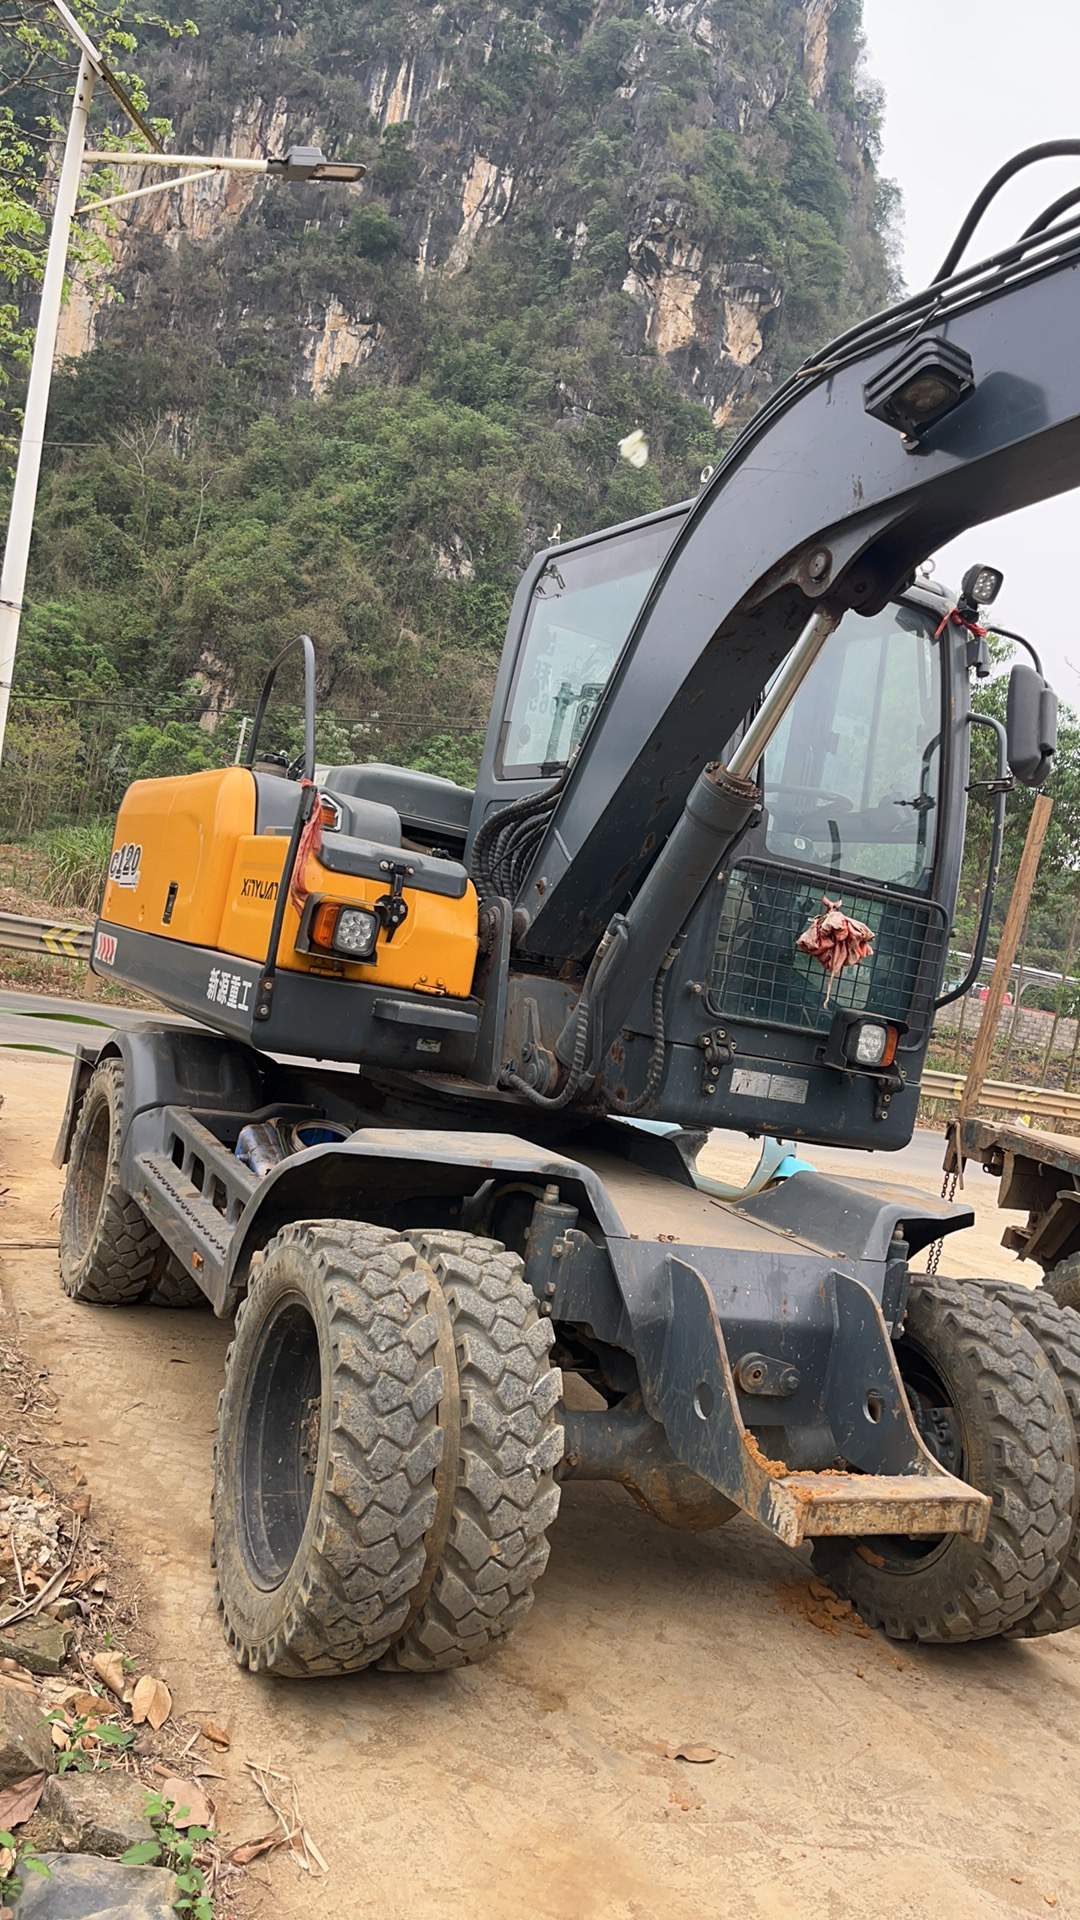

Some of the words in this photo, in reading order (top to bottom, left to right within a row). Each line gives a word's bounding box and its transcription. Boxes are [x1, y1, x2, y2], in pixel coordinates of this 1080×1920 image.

[109, 843, 142, 879] C120
[206, 967, 253, 1012] 新源重工
